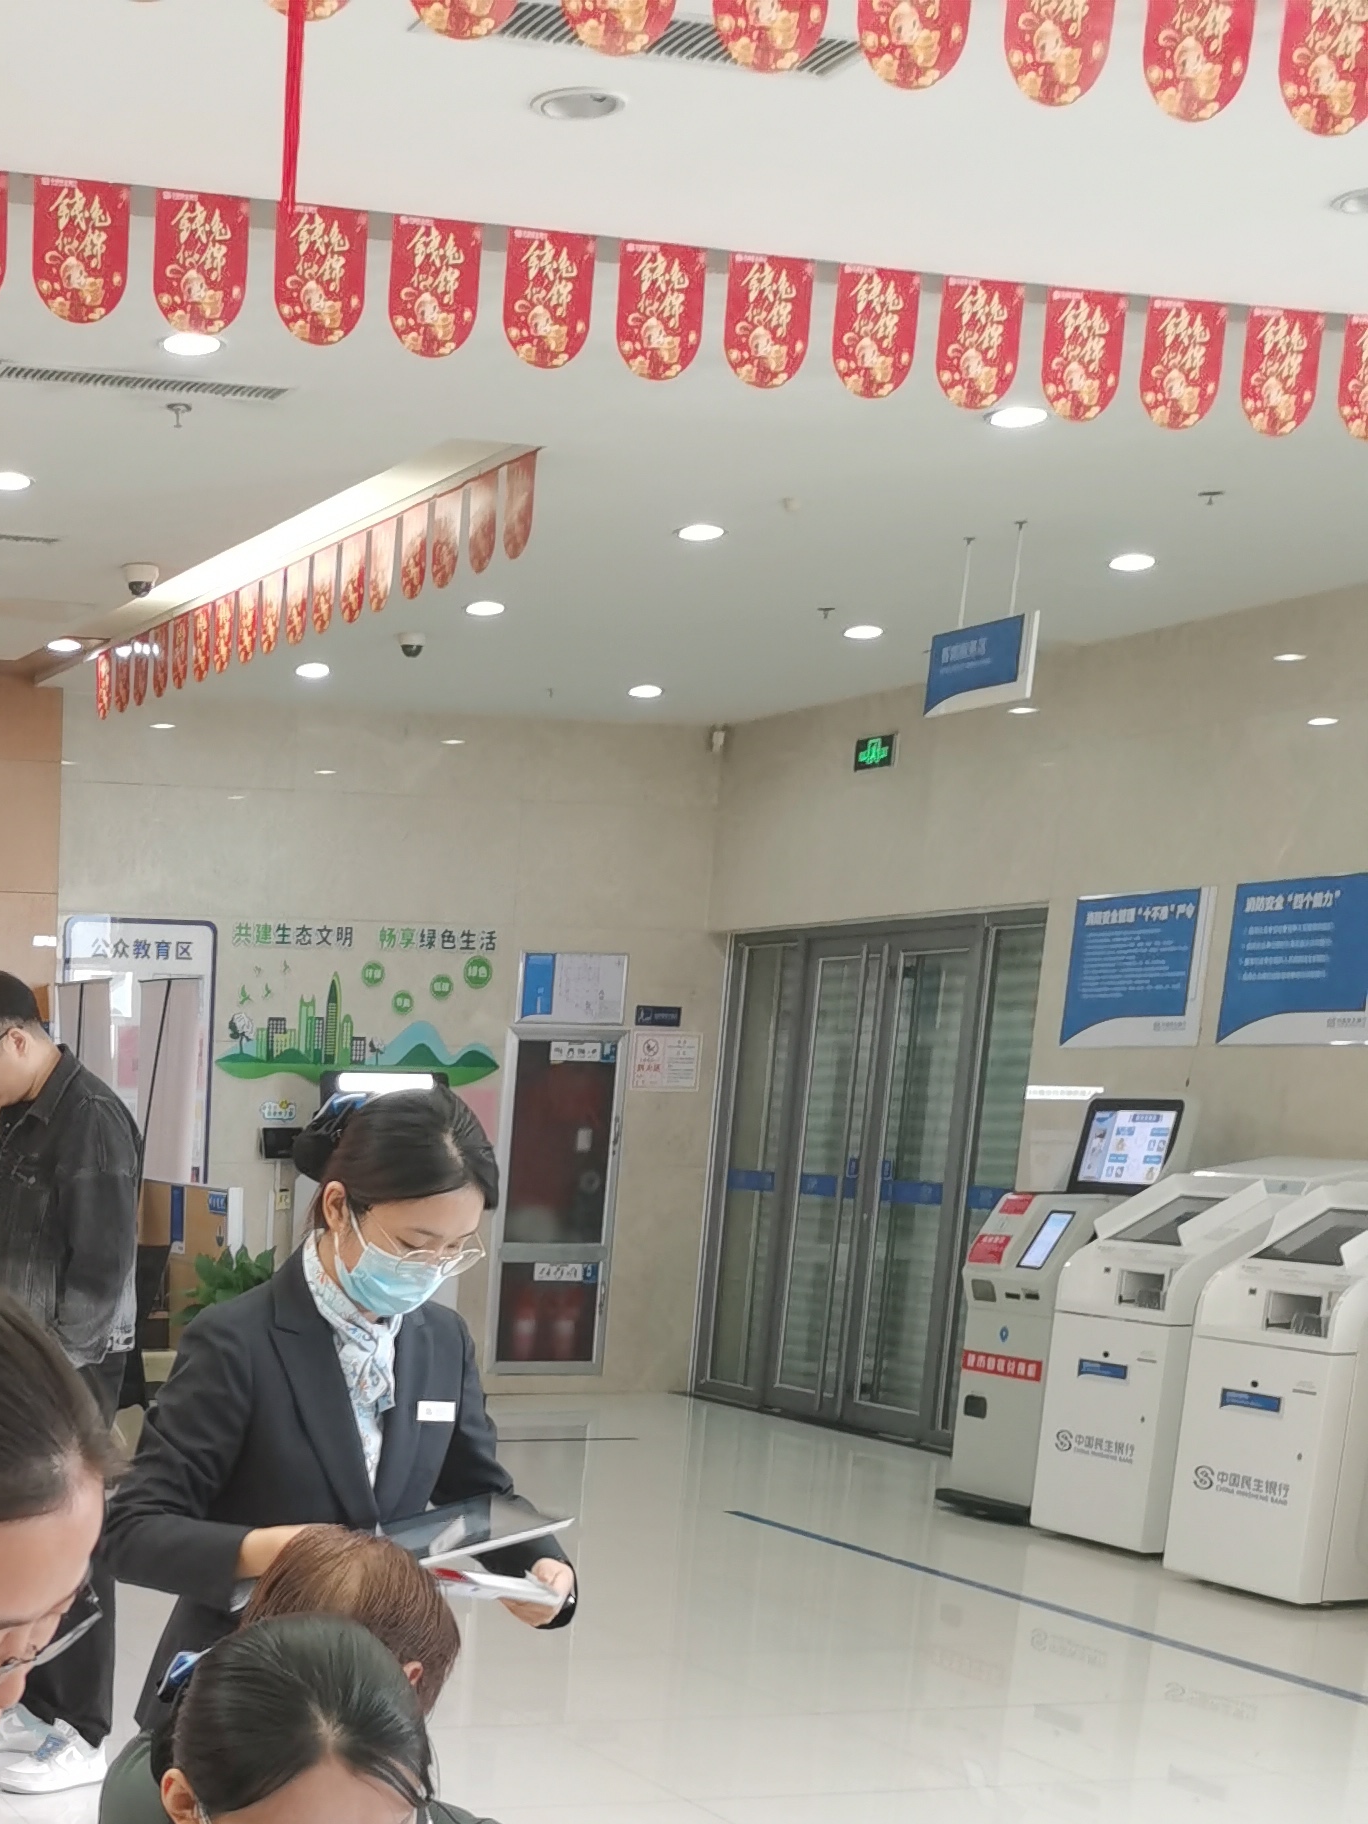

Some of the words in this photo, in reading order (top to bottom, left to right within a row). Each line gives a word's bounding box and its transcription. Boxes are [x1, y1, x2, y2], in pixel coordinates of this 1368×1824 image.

[91, 938, 193, 960] 公众教育区
[234, 922, 353, 947] 共建生态文明
[380, 926, 497, 951] 畅享绿色生活
[1075, 1434, 1134, 1457] 中国民生银行
[1217, 1471, 1290, 1498] 中国民生银行
